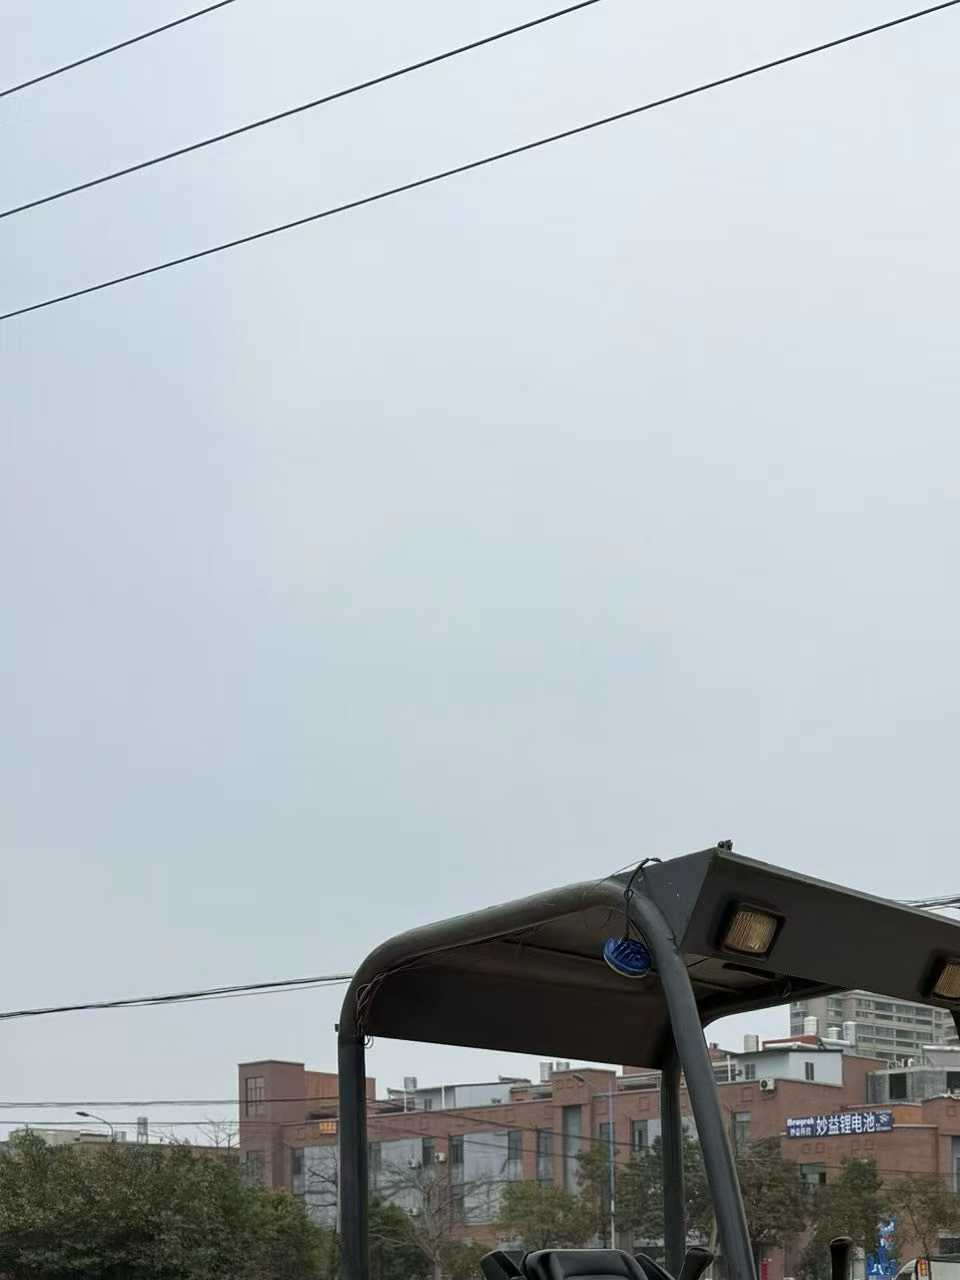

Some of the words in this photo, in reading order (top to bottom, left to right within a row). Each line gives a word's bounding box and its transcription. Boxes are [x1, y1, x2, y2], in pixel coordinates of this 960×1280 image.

[816, 1112, 875, 1136] 妙益锂电池
